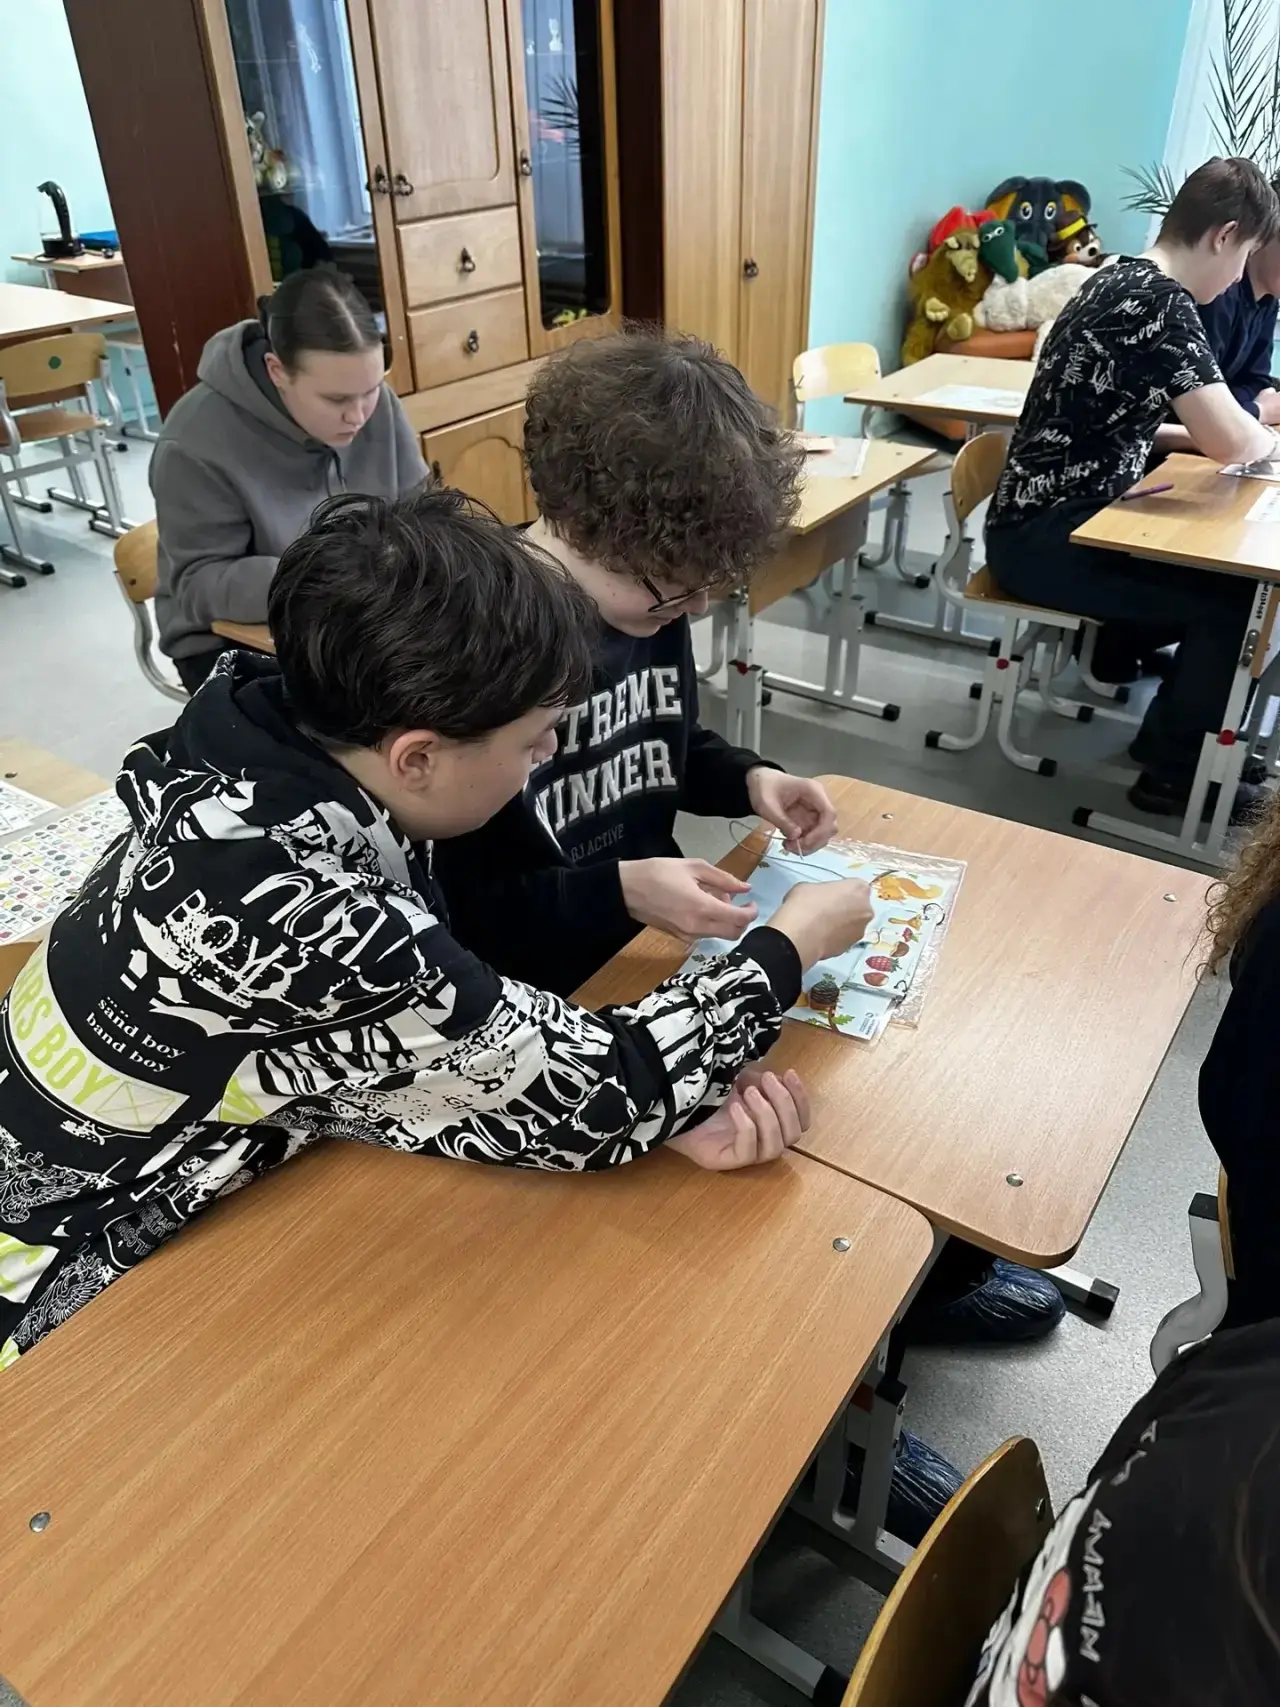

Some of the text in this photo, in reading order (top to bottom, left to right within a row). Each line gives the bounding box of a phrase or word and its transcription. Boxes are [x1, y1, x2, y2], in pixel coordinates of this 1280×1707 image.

[540, 666, 682, 760] TREME
[587, 823, 624, 856] ACTIVE
[27, 1022, 119, 1105] BOY
[86, 1012, 171, 1073] band boy
[142, 1034, 186, 1058] boy
